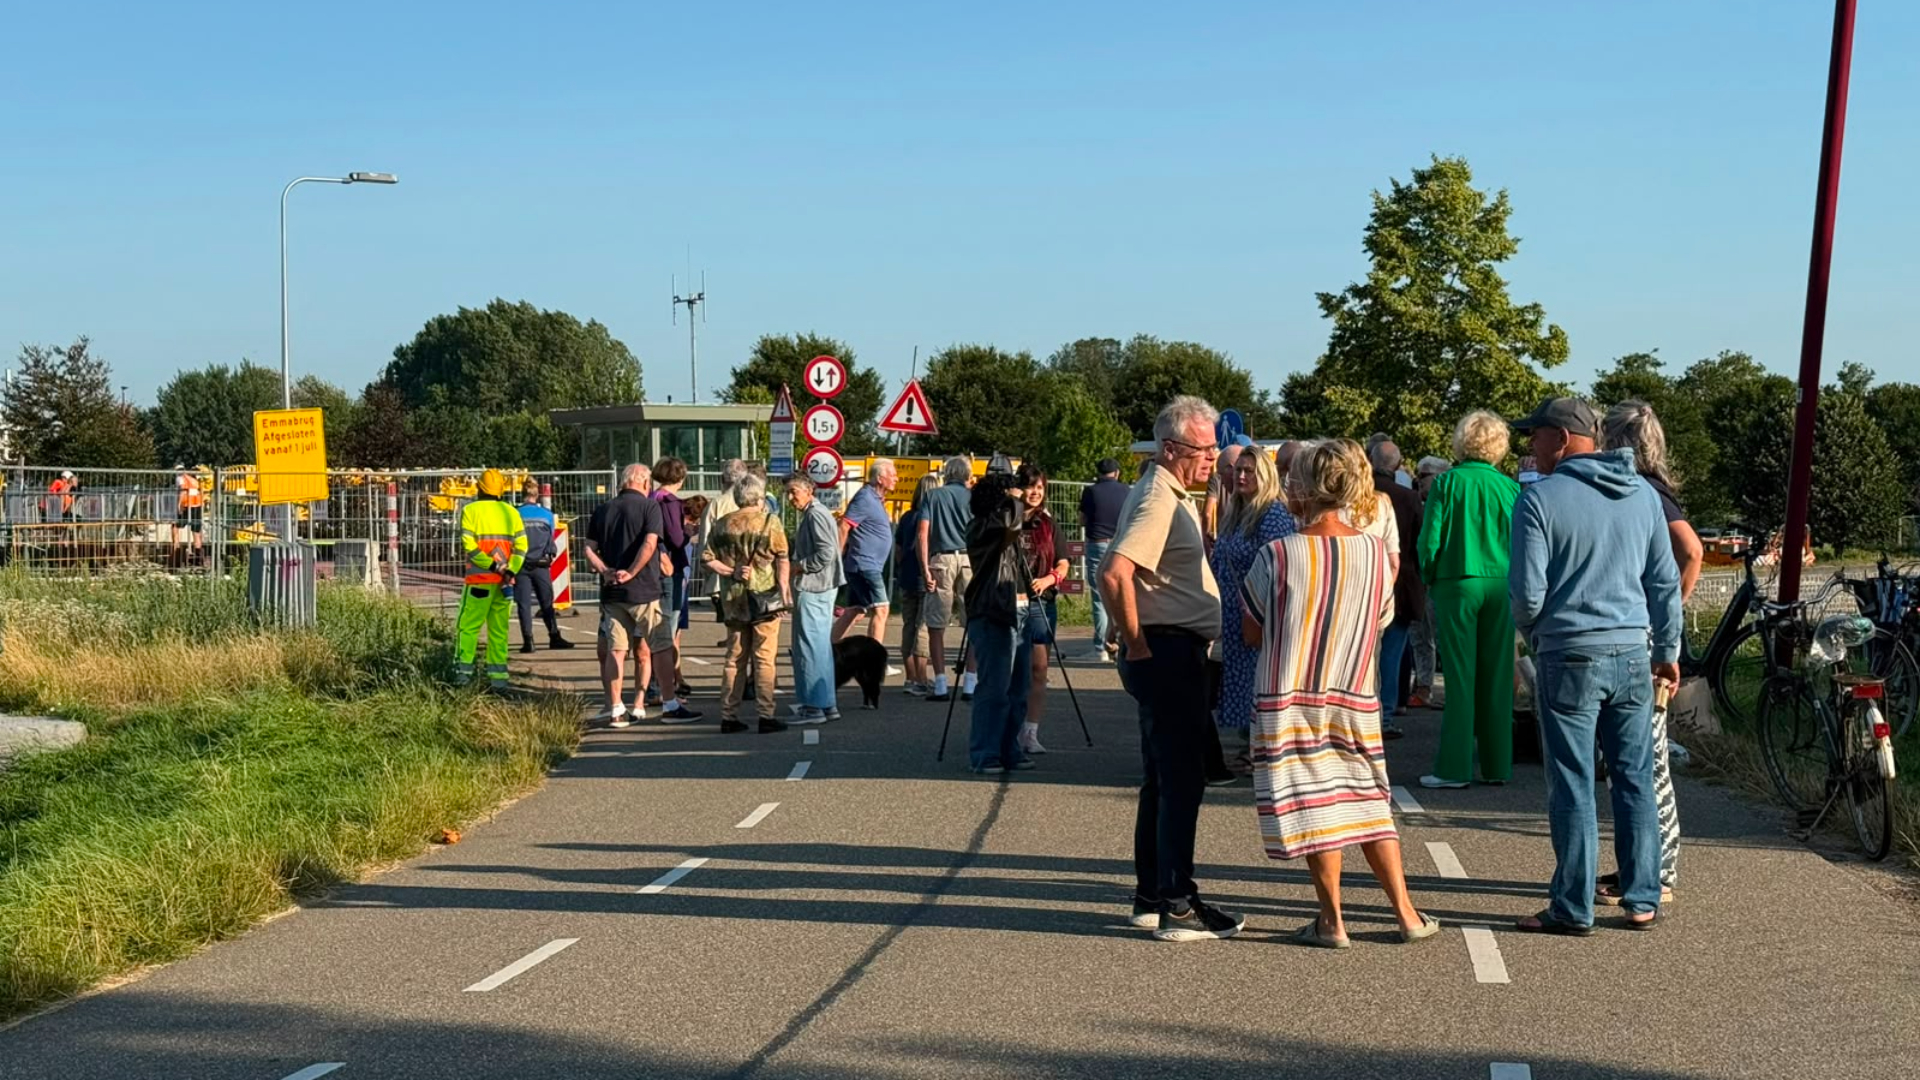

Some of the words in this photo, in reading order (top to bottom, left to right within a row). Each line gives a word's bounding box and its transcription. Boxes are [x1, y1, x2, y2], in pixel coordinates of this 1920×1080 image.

[262, 416, 315, 428] Emmabrug
[263, 429, 316, 443] Afgesloten
[263, 443, 293, 455] vanaf
[294, 442, 299, 453] 1
[301, 441, 317, 454] juli
